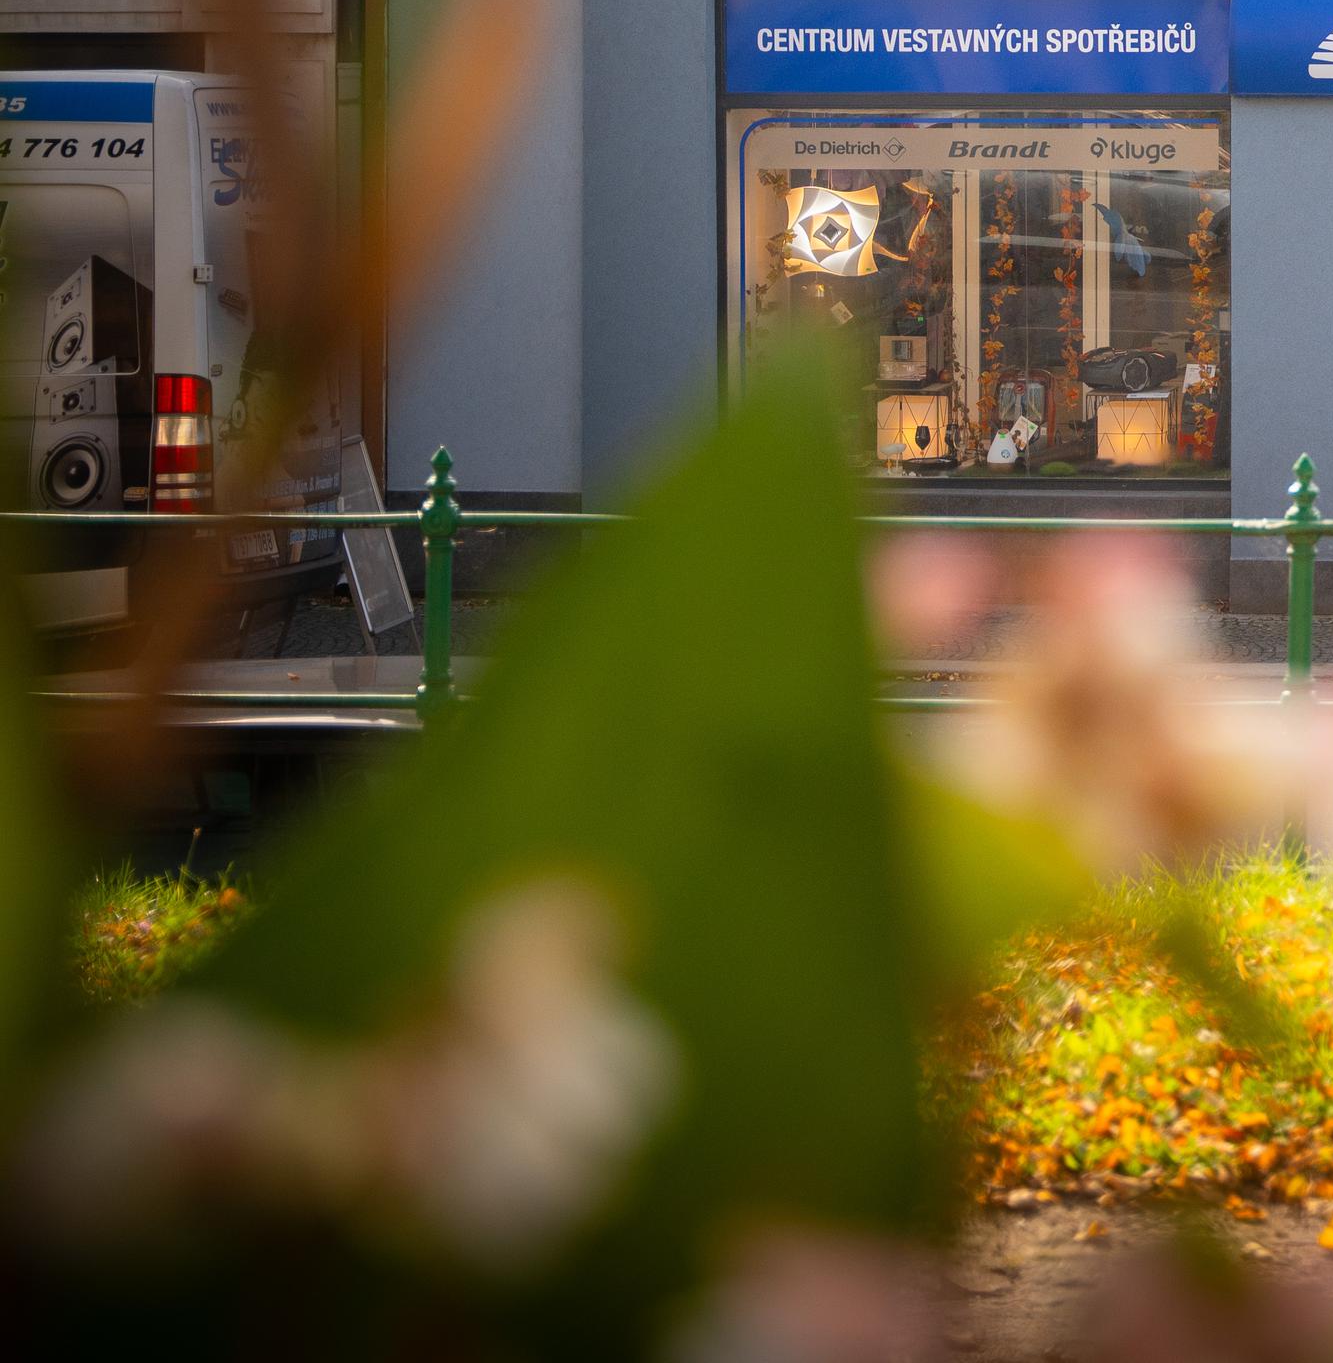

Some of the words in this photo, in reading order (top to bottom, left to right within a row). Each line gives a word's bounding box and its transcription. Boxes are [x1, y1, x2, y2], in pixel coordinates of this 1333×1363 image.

[757, 28, 875, 53] CENTRUM
[881, 23, 1038, 53] VESTAVNÝCH
[1045, 22, 1196, 53] SPOTŘEBIČŮ
[23, 138, 79, 158] 776
[91, 138, 145, 158] 104
[794, 140, 817, 155] De
[819, 140, 881, 155] Dietrich
[947, 140, 1051, 159] Brandt
[1110, 139, 1177, 165] kluge
